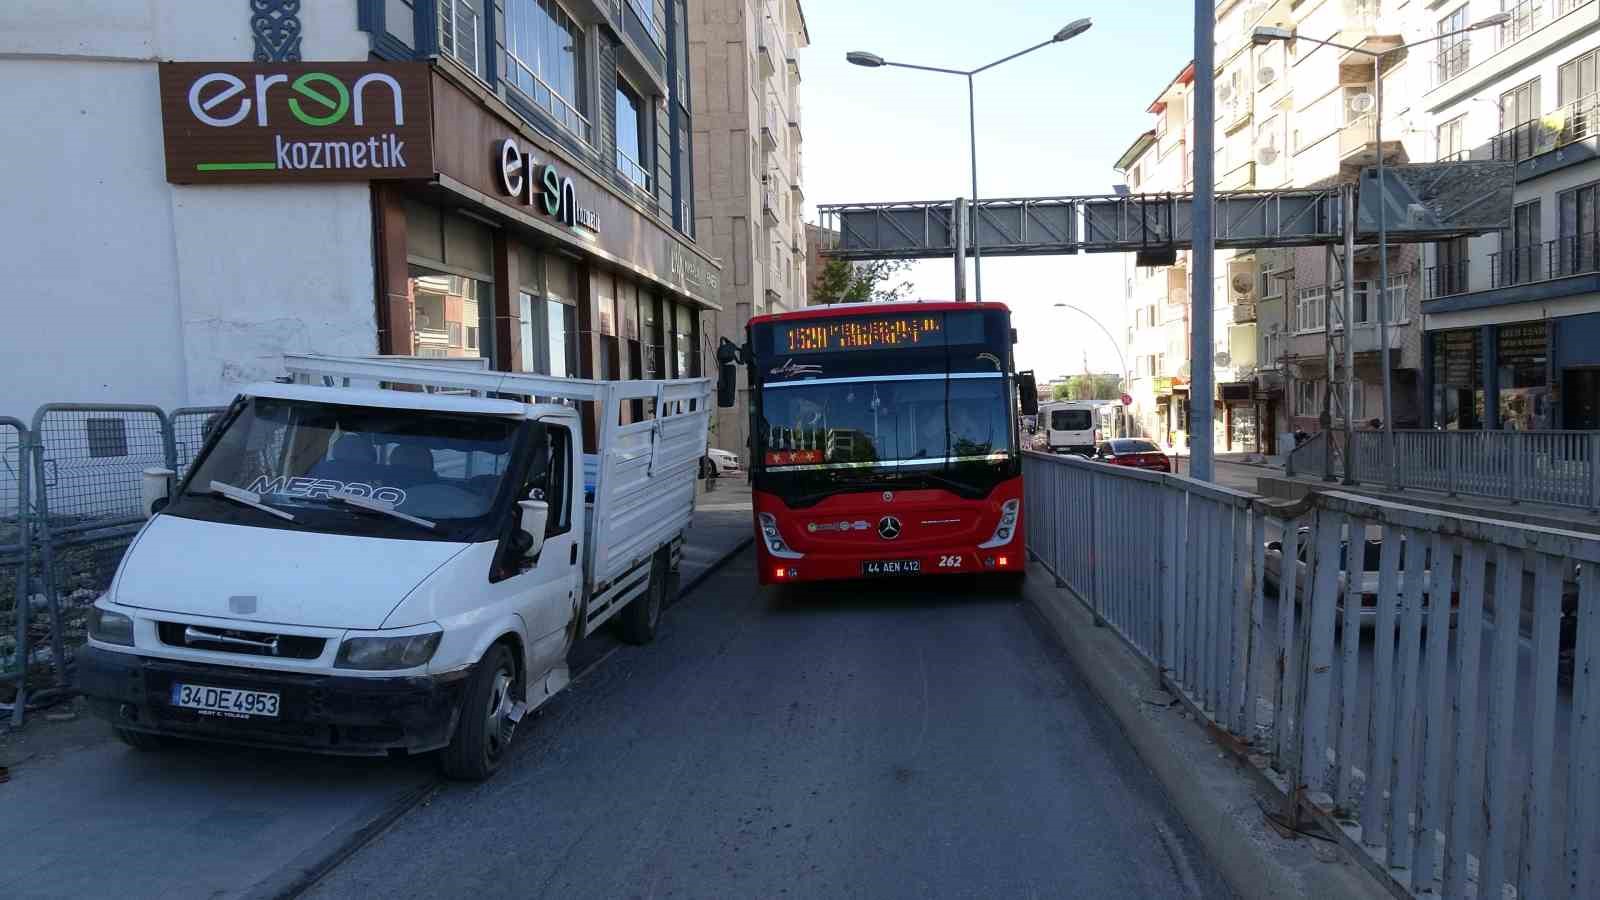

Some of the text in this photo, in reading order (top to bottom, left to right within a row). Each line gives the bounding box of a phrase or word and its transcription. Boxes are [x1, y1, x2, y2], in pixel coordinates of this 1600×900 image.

[188, 72, 405, 127] eren
[275, 133, 407, 169] kozmetik
[867, 560, 919, 573] 44 AEN 412
[938, 555, 963, 567] 262
[181, 686, 278, 714] 34 DE 4953
